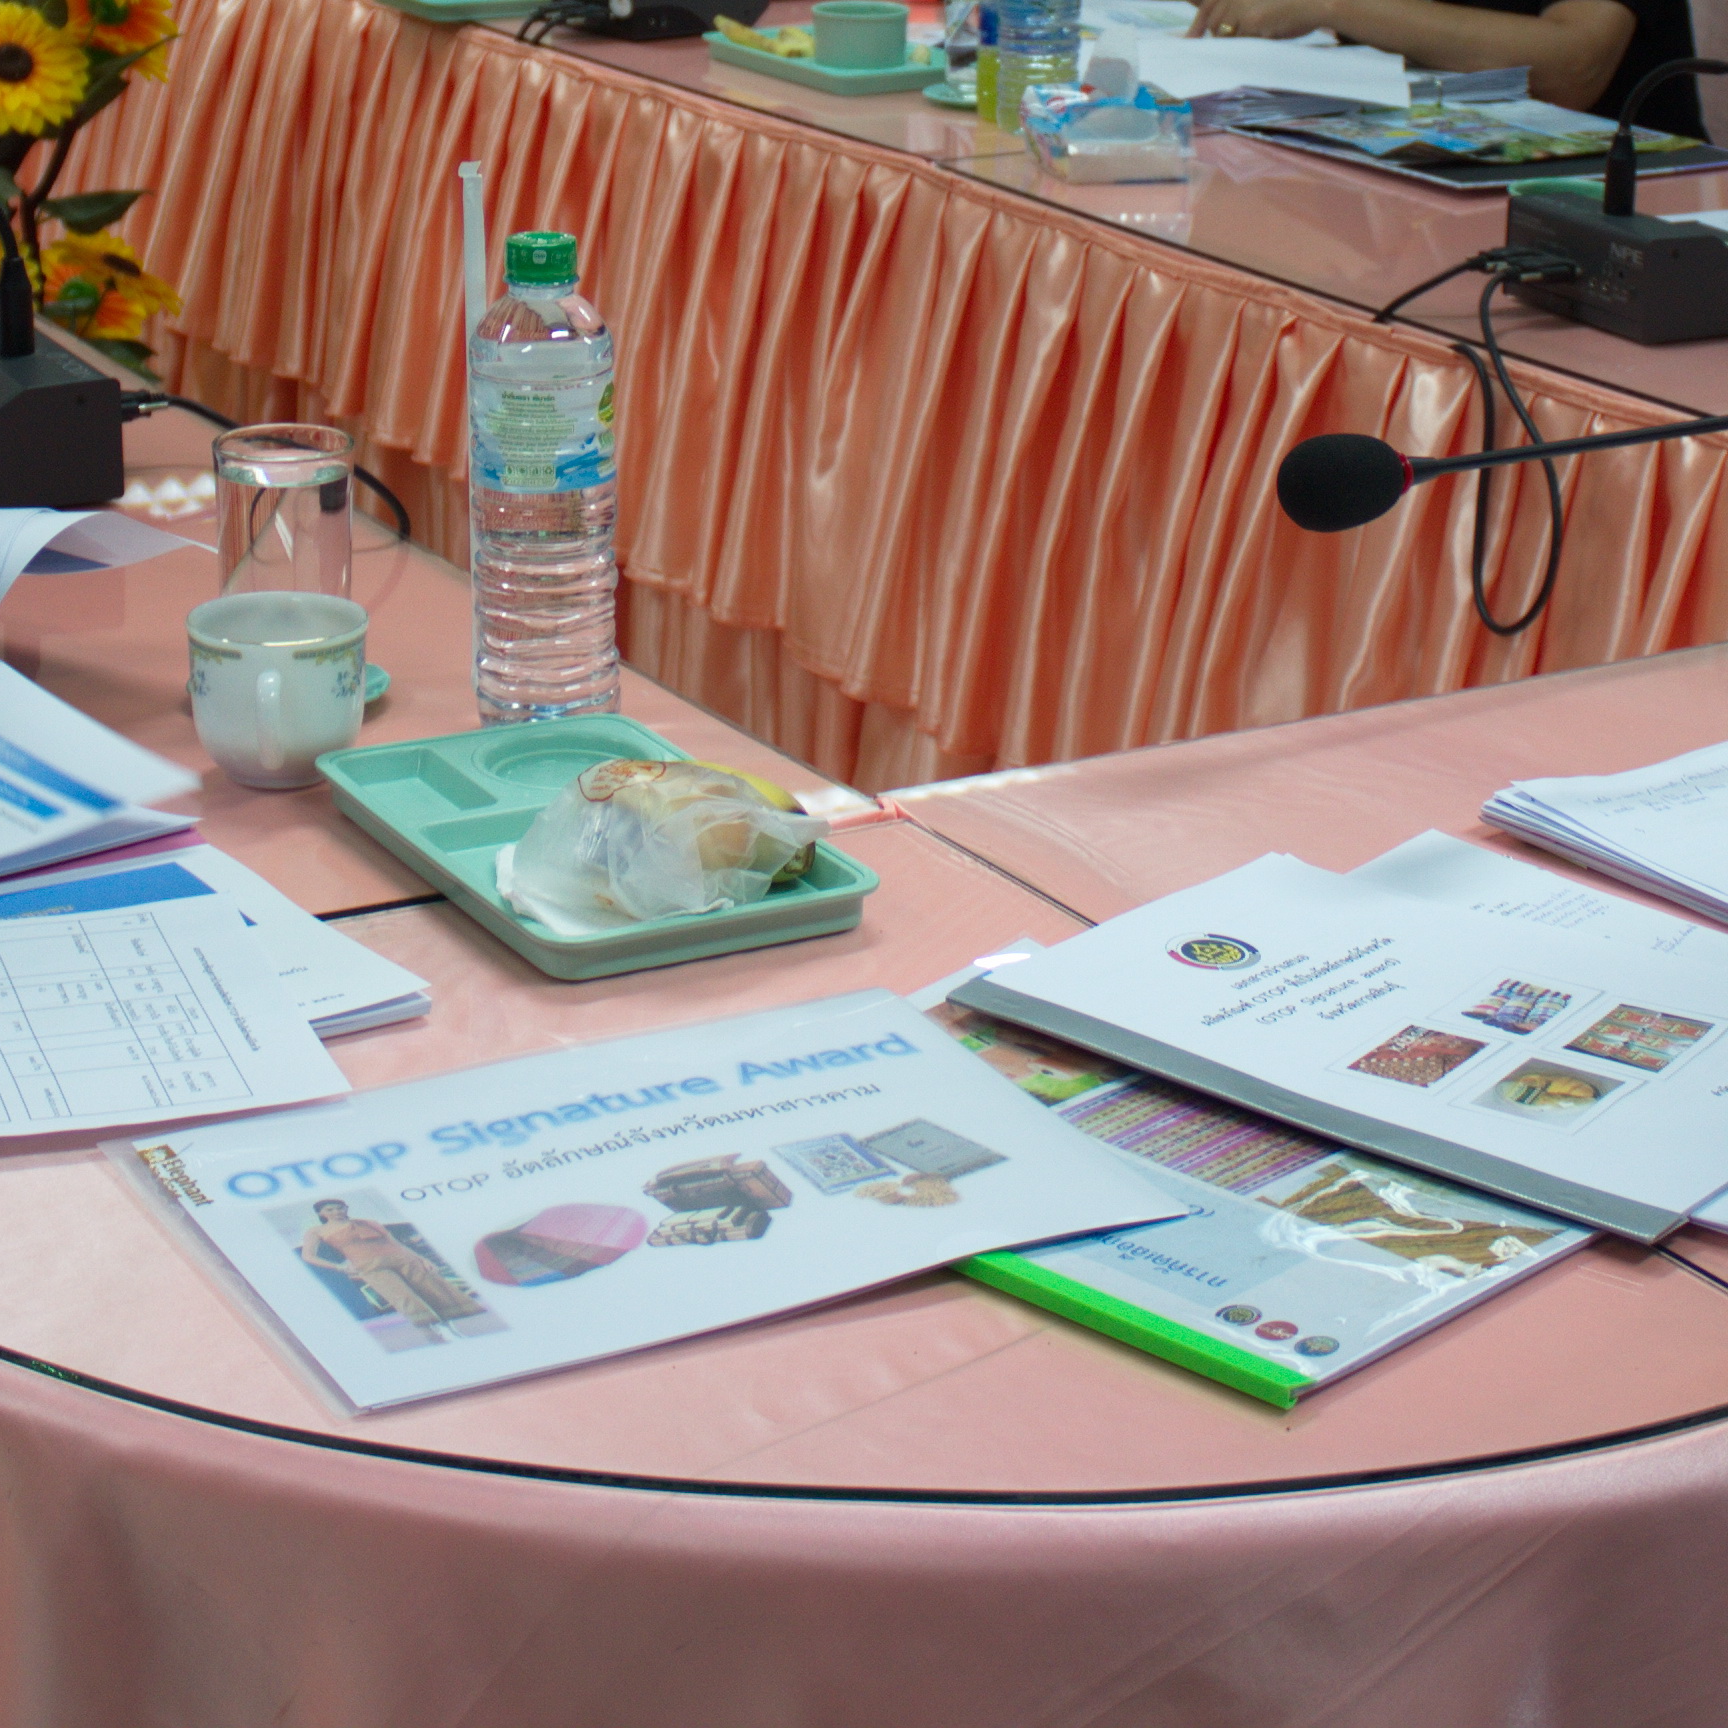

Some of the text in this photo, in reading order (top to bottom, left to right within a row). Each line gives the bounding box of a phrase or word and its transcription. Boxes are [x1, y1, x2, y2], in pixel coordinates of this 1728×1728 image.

[1251, 984, 1287, 1005] OTOP
[1255, 1004, 1298, 1025] (OTOP
[222, 1138, 411, 1202] OTOP
[427, 1060, 725, 1154] Signature
[735, 1030, 922, 1089] Award
[165, 1156, 215, 1208] Elephant
[398, 1172, 492, 1205] OTOP
